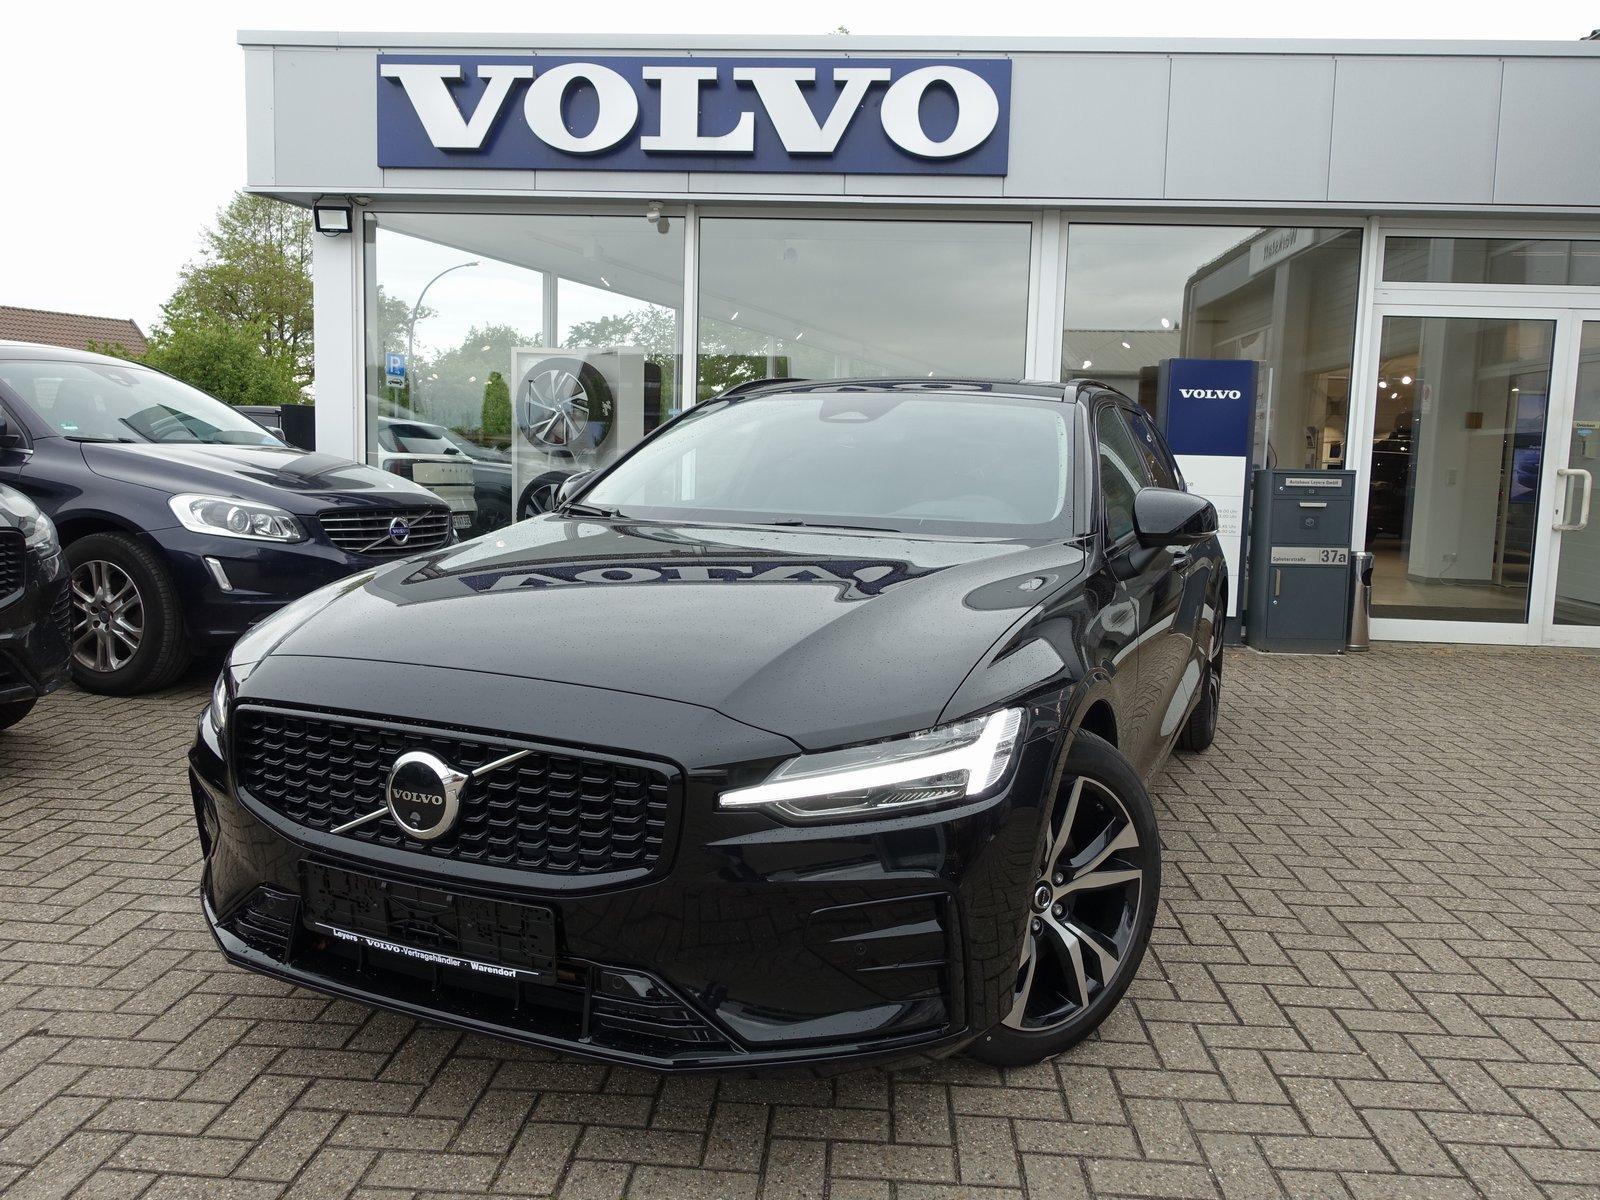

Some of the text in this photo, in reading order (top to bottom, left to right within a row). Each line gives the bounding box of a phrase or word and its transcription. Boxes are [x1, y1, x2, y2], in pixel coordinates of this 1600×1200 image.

[380, 62, 999, 158] VOLVO
[390, 355, 400, 373] P
[1179, 389, 1241, 400] VOLVO
[1321, 549, 1346, 563] 37a
[392, 788, 443, 805] VOLVO
[333, 929, 358, 942] Leyers
[470, 961, 516, 978] Warendorf
